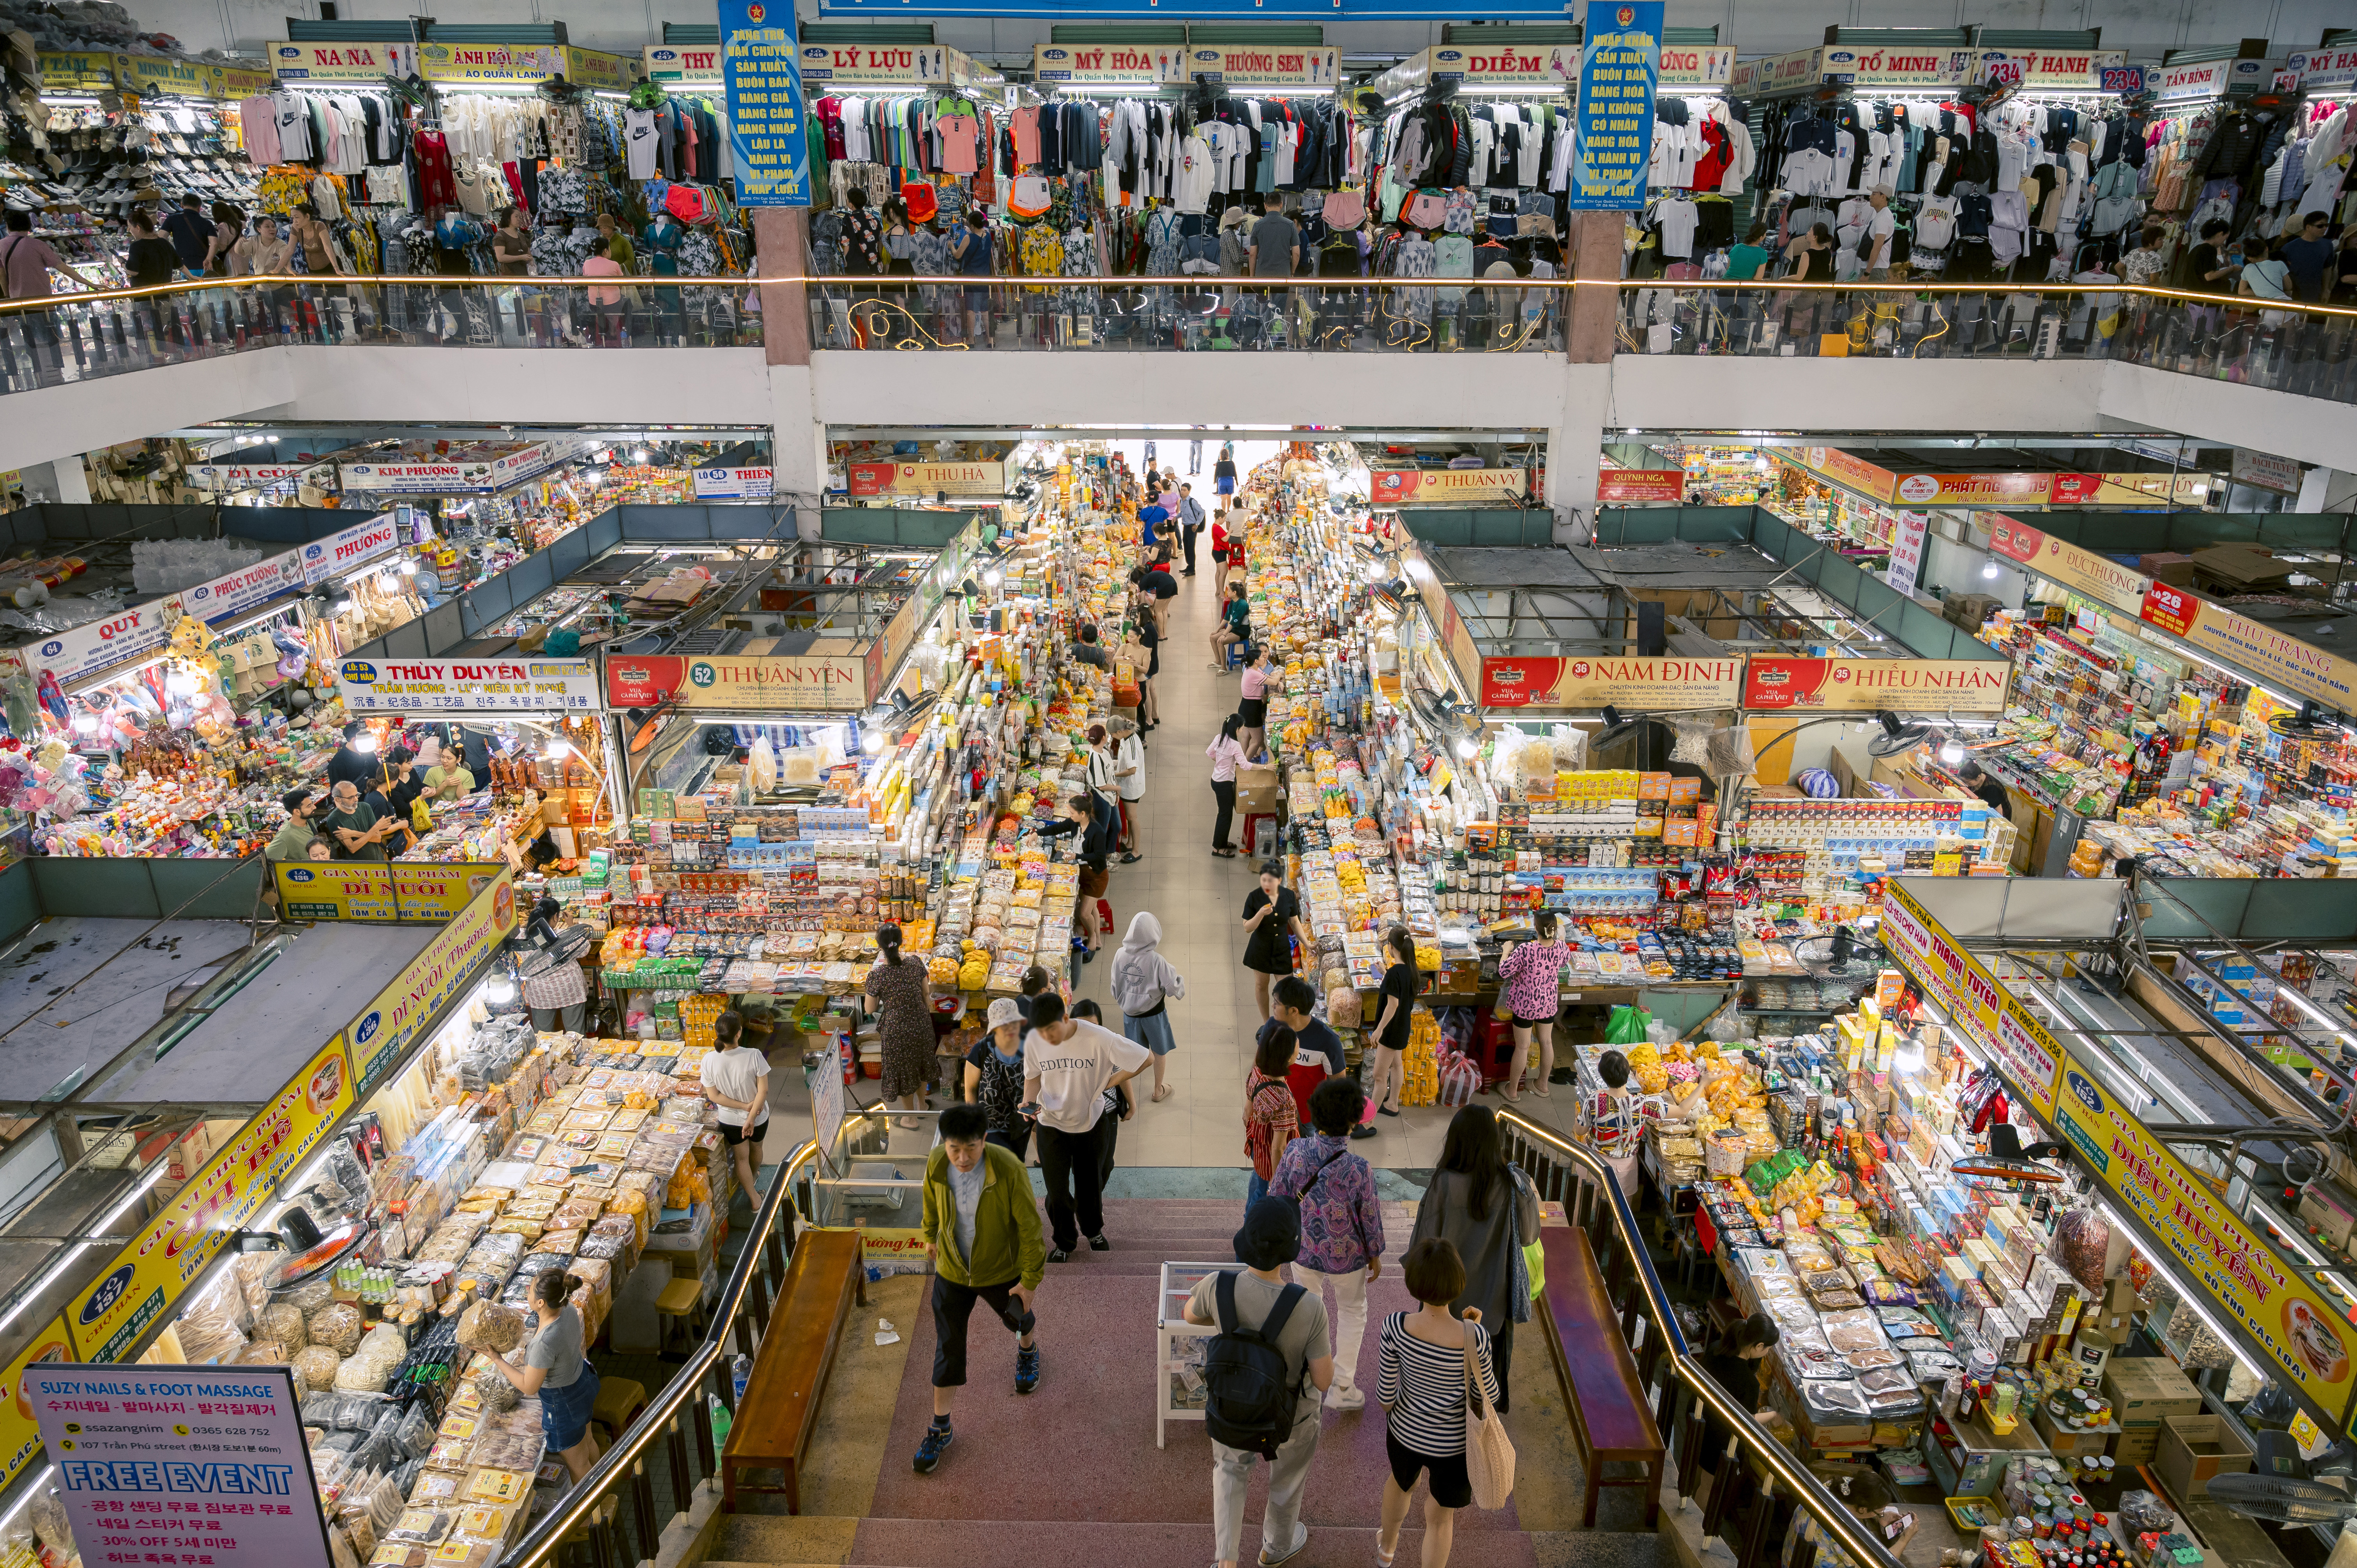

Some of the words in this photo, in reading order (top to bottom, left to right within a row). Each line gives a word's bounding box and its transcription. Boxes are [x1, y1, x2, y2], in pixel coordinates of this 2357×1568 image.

[732, 29, 760, 41] TÀNG
[763, 28, 784, 41] TRỮ
[1593, 33, 1621, 48] NHẬP
[1624, 31, 1653, 47] KHẨU
[314, 49, 344, 66] NA
[346, 49, 376, 66] NA
[454, 47, 483, 65] ÁNH
[727, 44, 749, 58] VẬN
[752, 42, 793, 56] CHUYỂN
[1619, 49, 1647, 64] XUẤT
[681, 52, 716, 69] THY
[736, 60, 757, 72] SẢN
[760, 58, 786, 72] XUẤT
[833, 45, 862, 68] LÝ
[868, 48, 913, 72] LỰU
[1075, 48, 1105, 70] MỸ
[1111, 48, 1153, 70] HÒA
[1225, 51, 1273, 73] HƯƠNG
[1276, 54, 1305, 73] SEN
[1468, 48, 1543, 72] DIỄM
[1857, 49, 1885, 71] TỐ
[1887, 56, 1939, 72] MINH
[1593, 67, 1622, 81] BUÔN
[1625, 67, 1647, 81] BÁN
[1990, 63, 2020, 83] 234
[2040, 57, 2090, 77] HẠNH
[736, 76, 765, 88] BUÔN
[769, 76, 790, 88] BÁN
[2105, 70, 2140, 90] 234
[2166, 69, 2189, 87] TẤN
[2189, 70, 2213, 84] BÌNH
[739, 92, 768, 103] HÀNG
[771, 90, 790, 103] GIẢ
[1591, 84, 1620, 97] HÀNG
[1623, 85, 1644, 97] HÓA
[738, 107, 767, 118] HÀNG
[770, 105, 793, 118] CẤM
[1589, 101, 1605, 114] MÀ
[1608, 101, 1644, 114] KHÔNG
[737, 123, 766, 134] HÀNG
[769, 122, 797, 135] NHẬP
[1592, 118, 1607, 131] CÓ
[1610, 118, 1638, 131] NHÃN
[751, 138, 770, 151] LẬU
[774, 138, 786, 149] LÀ
[1587, 135, 1615, 147] HÀNG
[1618, 135, 1639, 147] HÓA
[749, 153, 777, 164] HÀNH
[780, 154, 791, 164] VI
[1583, 151, 1595, 164] LÀ
[1598, 151, 1627, 164] HÀNH
[1630, 153, 1640, 164] VI
[749, 170, 760, 179] VI
[764, 170, 793, 181] PHẠM
[1589, 169, 1599, 180] VI
[1603, 169, 1633, 182] PHẠM
[745, 183, 772, 194] PHÁP
[775, 183, 799, 195] LUẬT
[1581, 184, 1608, 196] PHÁP
[1611, 184, 1636, 198] LUẬT
[378, 468, 402, 477] KIM
[406, 465, 459, 477] PHƯỢNG
[924, 468, 959, 481] THU
[963, 465, 986, 480] HÀ
[1442, 471, 1497, 488] THUẬN
[1500, 471, 1519, 485] VỸ
[335, 528, 392, 561] PHƯƠNG
[332, 560, 353, 572] Souvenir
[357, 548, 380, 563] Handmade
[381, 541, 396, 553] Product
[2067, 552, 2089, 572] ĐỨC
[2090, 560, 2136, 592] THƯƠNG
[214, 577, 242, 598] PHÚC
[244, 563, 279, 586] TƯỜNG
[2225, 616, 2263, 642] THU
[2267, 633, 2333, 672] TRANG
[386, 661, 445, 680] THÙY
[452, 662, 527, 680] DUYÊN
[695, 667, 711, 683] 52
[717, 663, 803, 686] THUẬN
[1575, 664, 1587, 673] 36
[1593, 661, 1656, 681] NAM
[1661, 662, 1736, 684] ĐỊNH
[1836, 669, 1847, 678] 35
[1854, 662, 1919, 687] HIẾU
[1923, 666, 2004, 688] NHÂN
[370, 680, 403, 694] TRẦM
[406, 683, 446, 694] HƯƠNG
[484, 682, 511, 695] NIỆM
[514, 682, 531, 694] MỸ
[535, 681, 567, 694] NGHỆ
[353, 696, 376, 707] 沉香
[388, 696, 422, 707] 纪念品
[433, 696, 464, 707] 工艺品
[341, 879, 373, 895] DÌ
[378, 879, 449, 896] NUÔI
[1933, 934, 1963, 977] THANH
[392, 996, 410, 1029] DÌ
[410, 962, 443, 1010] NUÔI
[2008, 999, 2019, 1014] ĐT:
[2019, 1012, 2034, 1032] 0905
[2035, 1028, 2047, 1045] 215
[2048, 1041, 2061, 1058] 558
[1039, 1058, 1095, 1071] EDITION
[2076, 1084, 2094, 1108] 152
[138, 1218, 176, 1256] GIA
[178, 1190, 201, 1211] VỊ
[203, 1134, 253, 1189] THỰC
[255, 1083, 303, 1138] PHẨM
[2110, 1133, 2172, 1202] DIỆU
[165, 1173, 239, 1259] CHỊ
[244, 1116, 292, 1179] BÊ
[2108, 1110, 2139, 1146] GIA
[2143, 1141, 2163, 1168] VỊ
[2166, 1164, 2219, 1222] THỰC
[2223, 1218, 2288, 1290] PHẨM
[95, 1280, 123, 1313] 137
[41, 1381, 80, 1395] SUZY
[85, 1383, 131, 1395] NAILS
[136, 1384, 147, 1395] &
[150, 1384, 193, 1397] FOOT
[198, 1384, 274, 1398] MASSAGE
[47, 1400, 110, 1413] 수지네일
[123, 1402, 186, 1414] 발마사지
[198, 1403, 276, 1416] 발각질제거
[85, 1423, 164, 1435] ssazangnim
[225, 1427, 247, 1435] 628
[249, 1428, 270, 1436] 752
[102, 1441, 128, 1450] Trần
[154, 1443, 186, 1451] street
[61, 1461, 163, 1492] FREE
[163, 1462, 293, 1495] EVENT
[91, 1501, 124, 1512] 공항
[129, 1501, 162, 1513] 샌딩
[167, 1501, 201, 1513] 무료
[205, 1502, 255, 1515] 짐보관
[259, 1503, 293, 1515] 무료
[97, 1519, 130, 1530] 네일
[135, 1519, 184, 1531] 스티커
[189, 1520, 223, 1531] 무료
[102, 1536, 136, 1546] 30%
[140, 1537, 169, 1546] OFF
[174, 1537, 200, 1548] 5세
[205, 1538, 237, 1549] 미만
